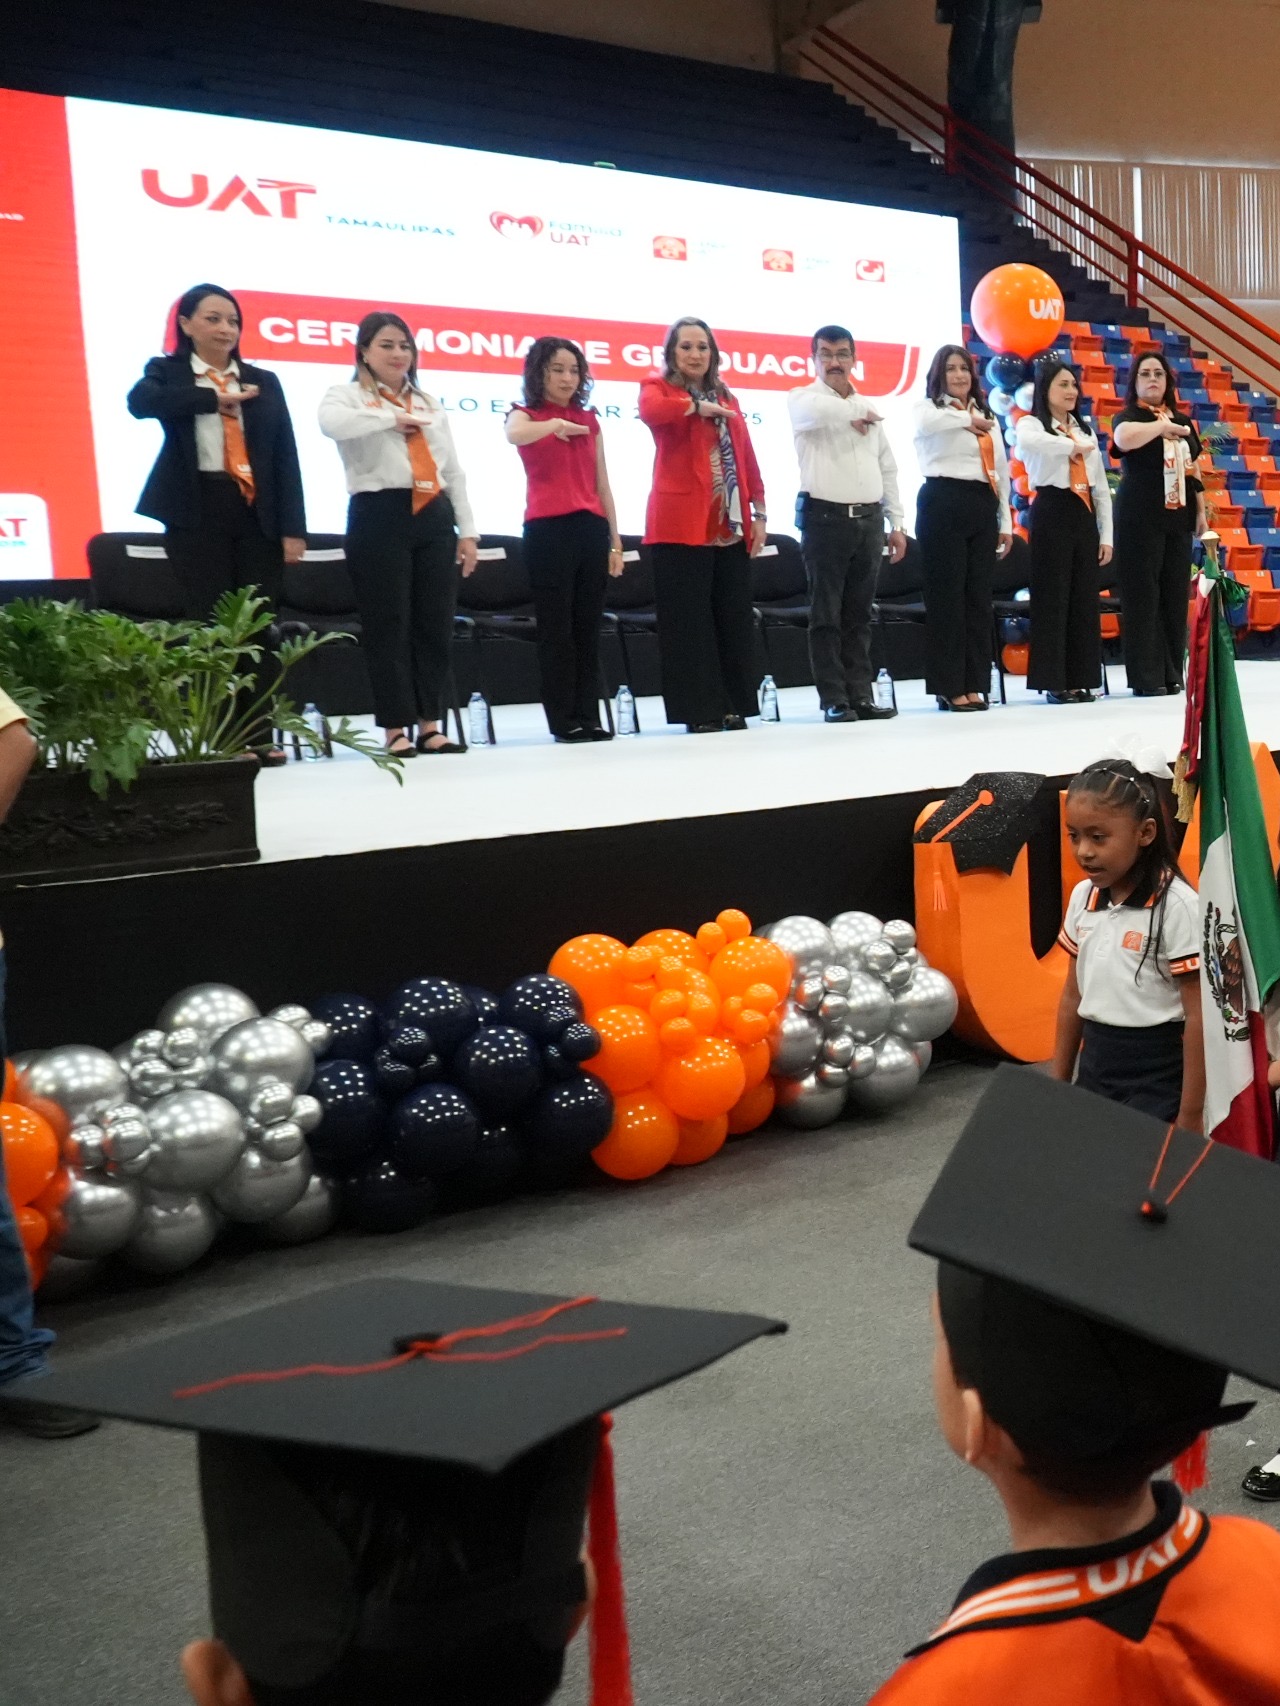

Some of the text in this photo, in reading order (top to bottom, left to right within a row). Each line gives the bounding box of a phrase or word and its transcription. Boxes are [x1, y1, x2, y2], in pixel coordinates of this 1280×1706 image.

[141, 168, 317, 219] UAT
[326, 215, 456, 237] TAMAULIPAS
[550, 232, 590, 246] UAT
[1028, 297, 1062, 321] UAT
[258, 316, 536, 358] CERMONIA
[621, 343, 866, 382] GDUACIN
